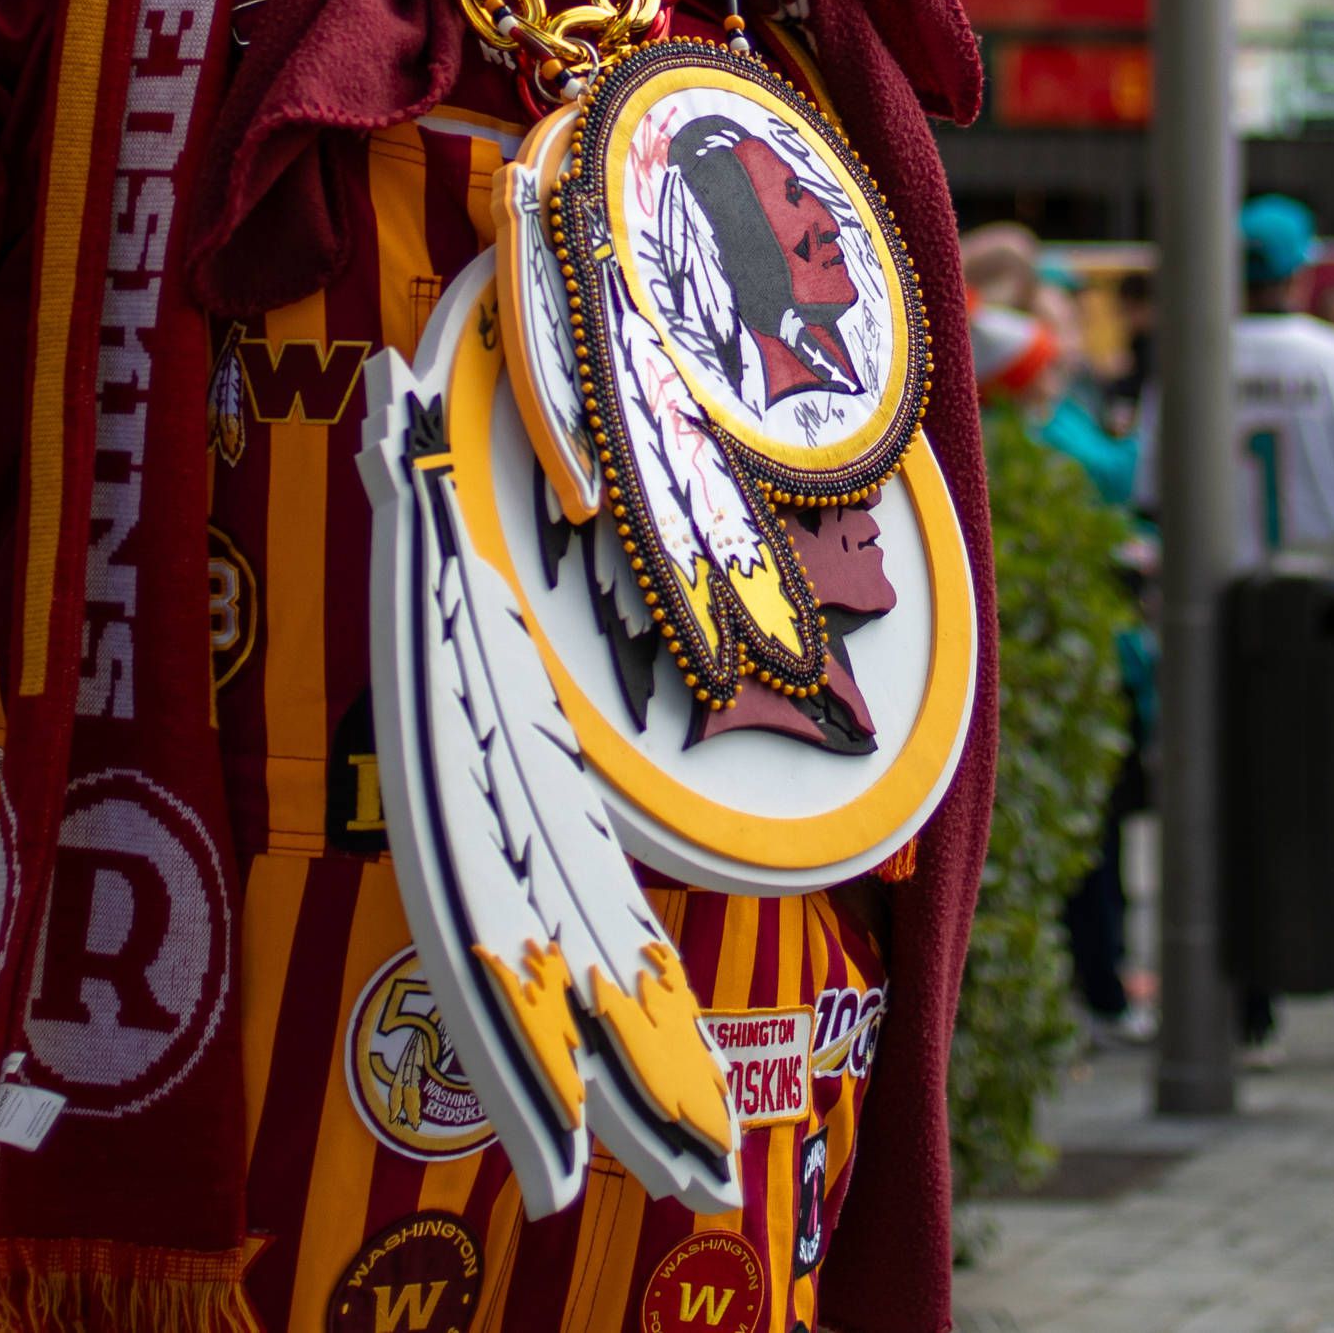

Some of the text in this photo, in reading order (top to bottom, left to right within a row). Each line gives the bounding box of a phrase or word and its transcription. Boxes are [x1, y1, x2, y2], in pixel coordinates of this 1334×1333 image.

[235, 338, 373, 426] W
[29, 844, 186, 1034] R
[707, 1018, 795, 1050] ASHINGTON
[423, 1078, 477, 1108] WASHING
[727, 1054, 803, 1115] DSKINS
[423, 1099, 484, 1124] REDSKI
[348, 1220, 479, 1288] WASHINGTON
[660, 1238, 759, 1291] WASHINGTON
[373, 1280, 449, 1333] W
[679, 1281, 736, 1326] W
